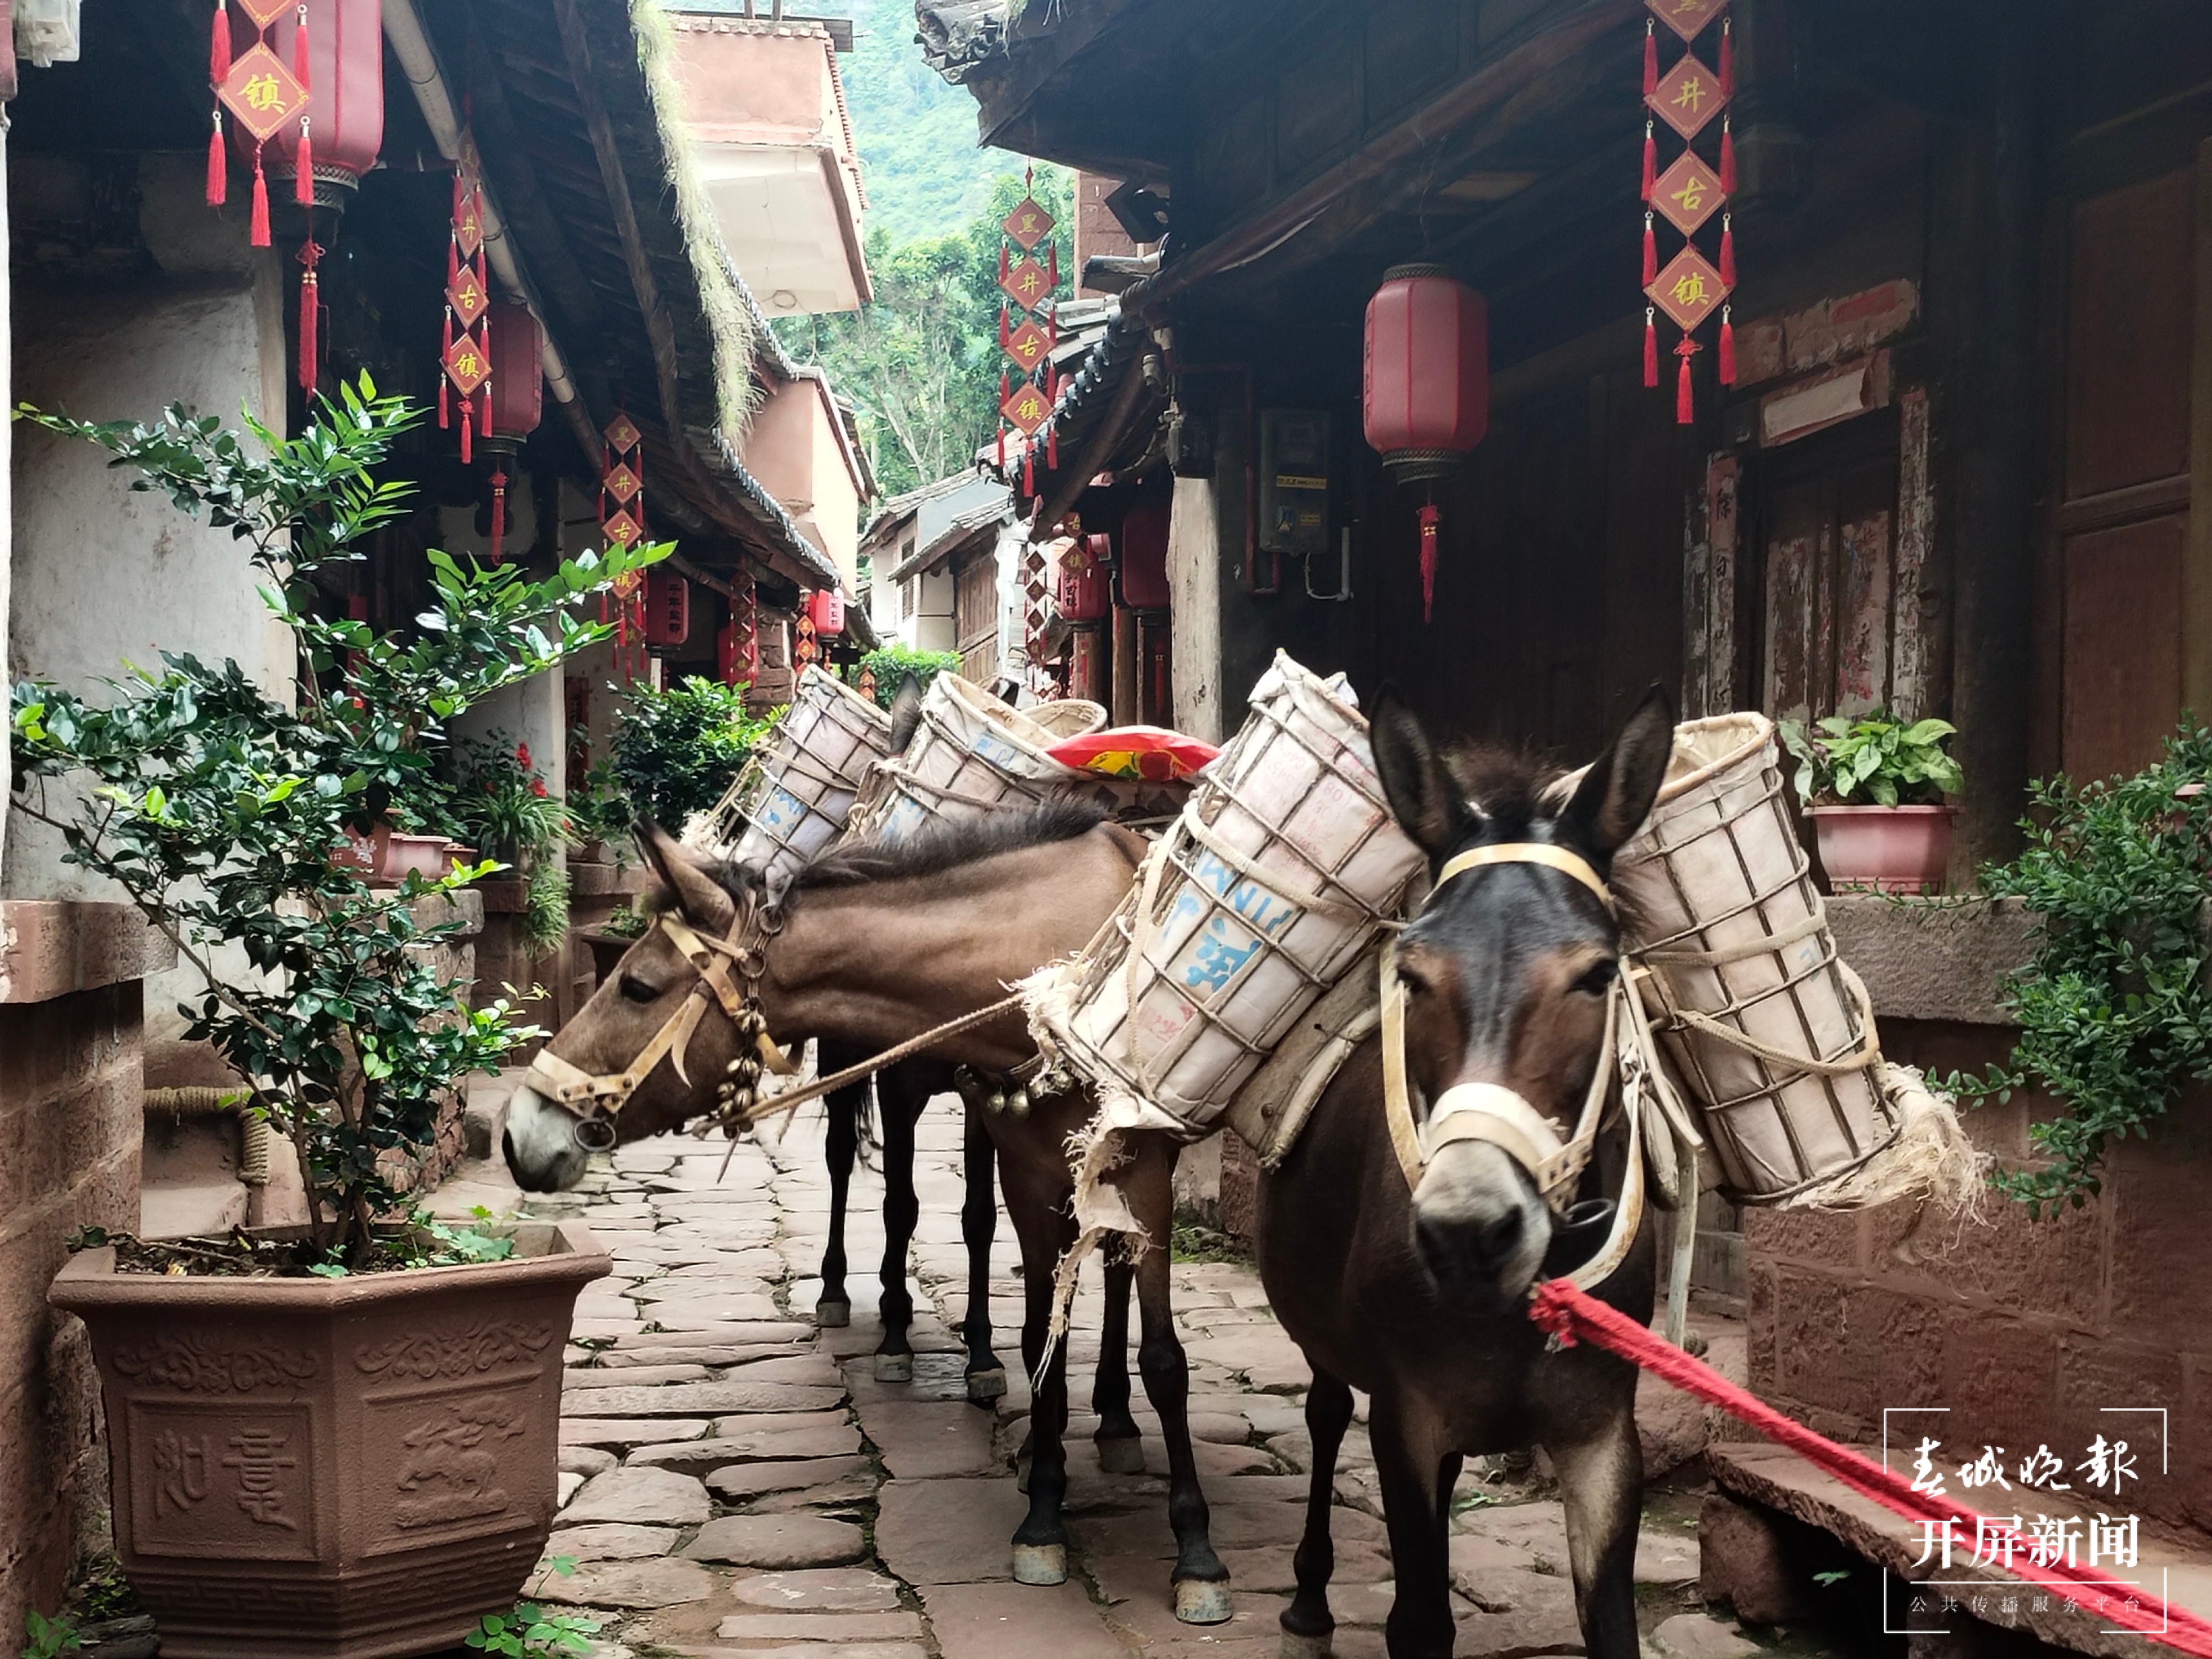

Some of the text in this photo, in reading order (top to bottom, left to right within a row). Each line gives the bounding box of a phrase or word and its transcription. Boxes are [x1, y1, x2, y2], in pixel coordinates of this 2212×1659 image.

[237, 73, 286, 114] 镇
[1016, 214, 1042, 420] 黑井古镇
